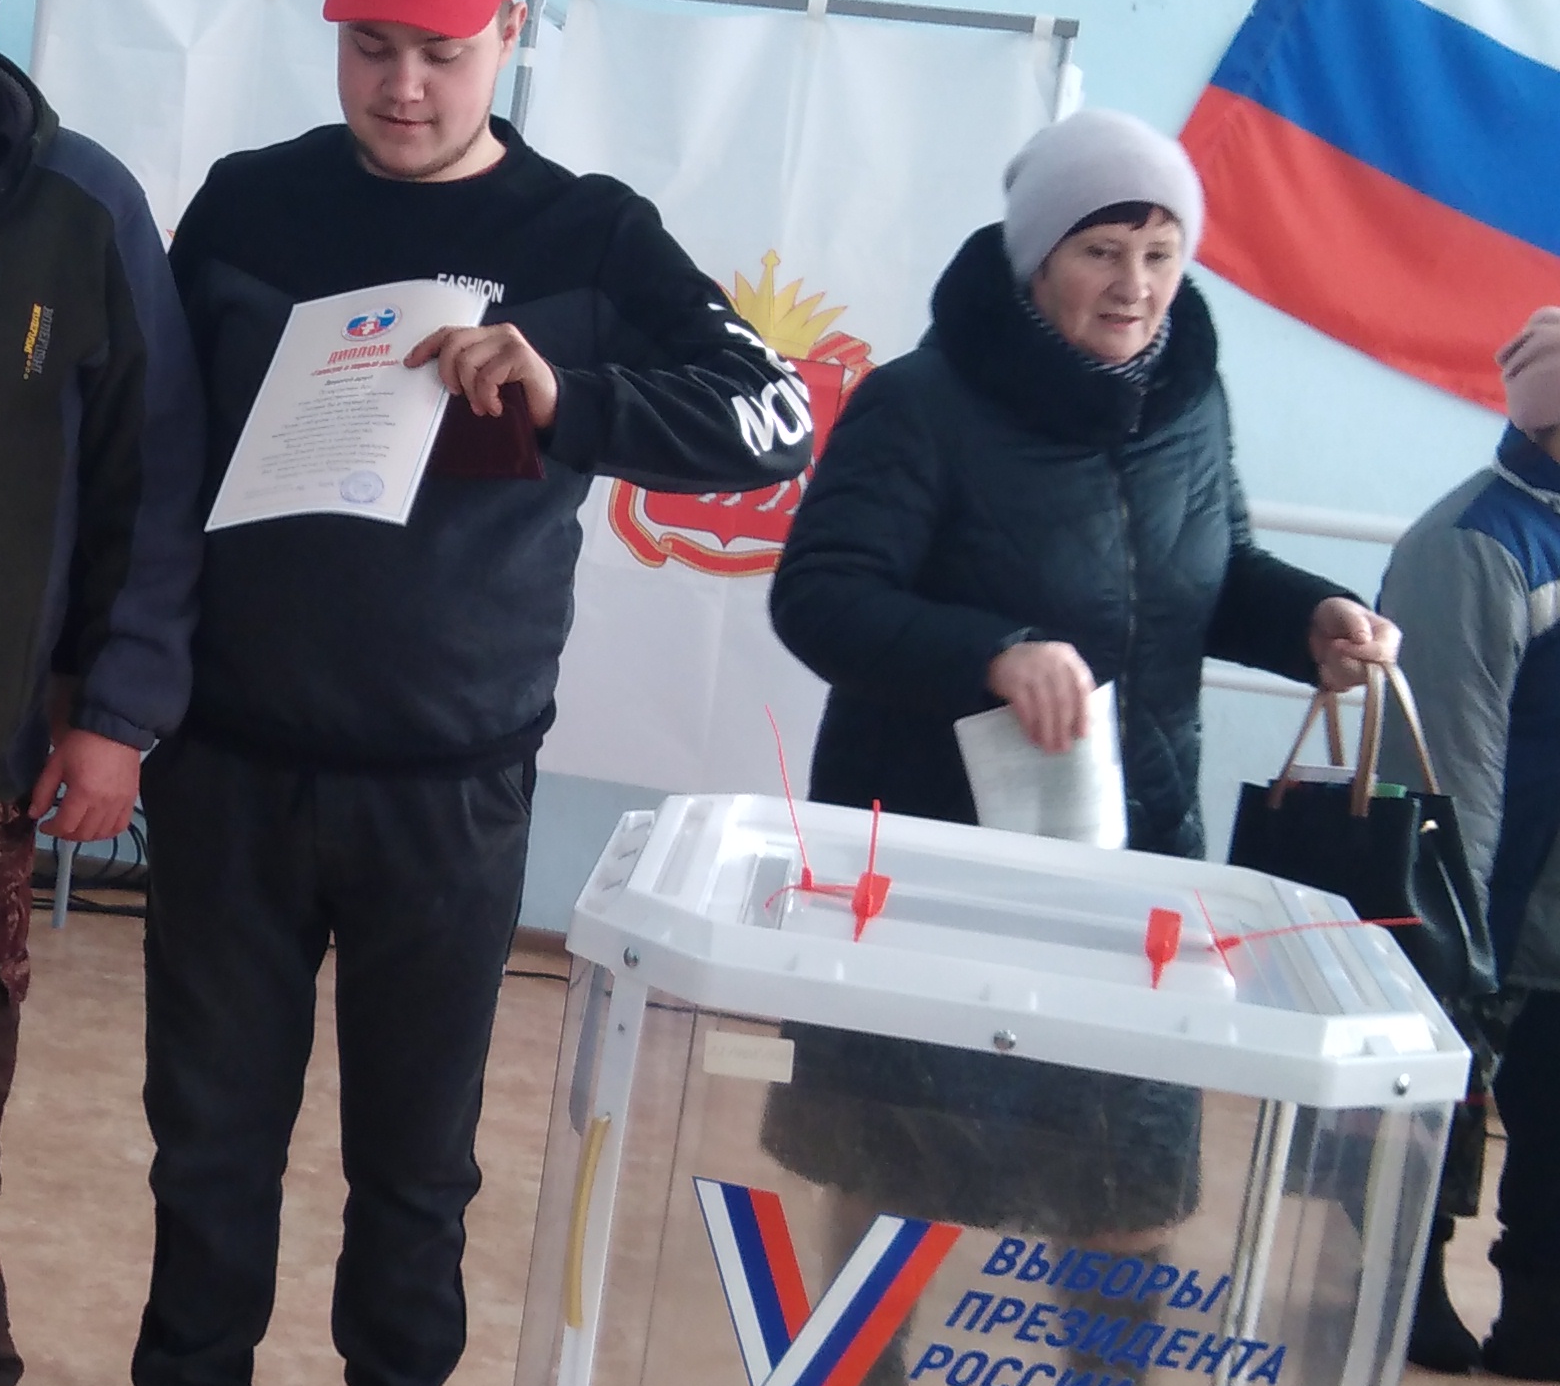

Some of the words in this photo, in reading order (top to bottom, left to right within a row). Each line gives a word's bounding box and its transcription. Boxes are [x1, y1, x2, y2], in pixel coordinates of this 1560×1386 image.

[327, 343, 391, 365] ДИПЛОМ
[981, 1235, 1231, 1314] ВЫБОРЫ
[945, 1289, 1287, 1386] ПРЕЗИДЕНТА
